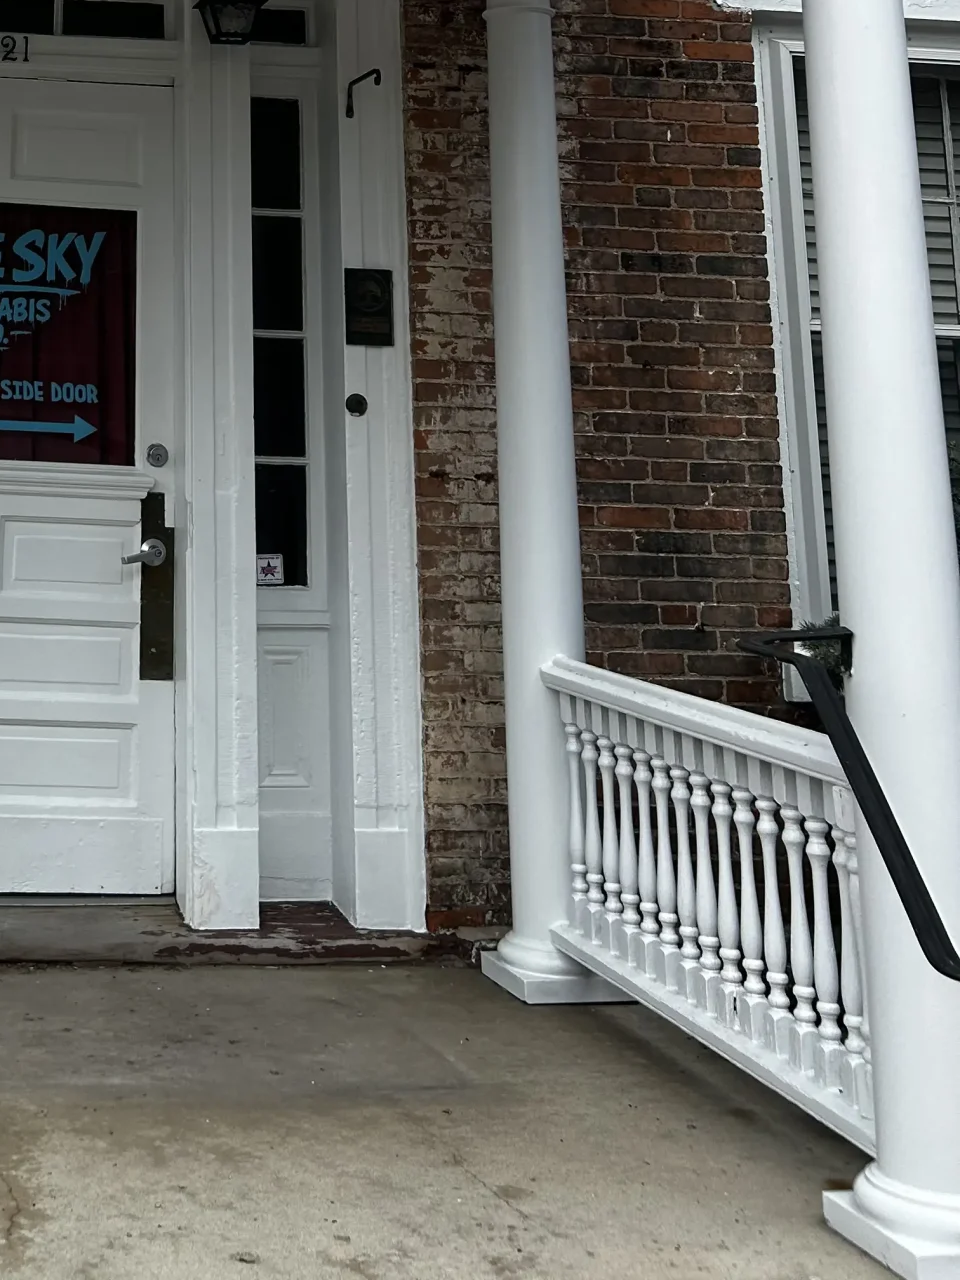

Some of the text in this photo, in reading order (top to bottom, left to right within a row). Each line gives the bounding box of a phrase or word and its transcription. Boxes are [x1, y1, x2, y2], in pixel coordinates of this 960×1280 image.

[11, 228, 107, 286] SKY
[0, 379, 44, 402] SIDE
[50, 381, 99, 404] DOOR
